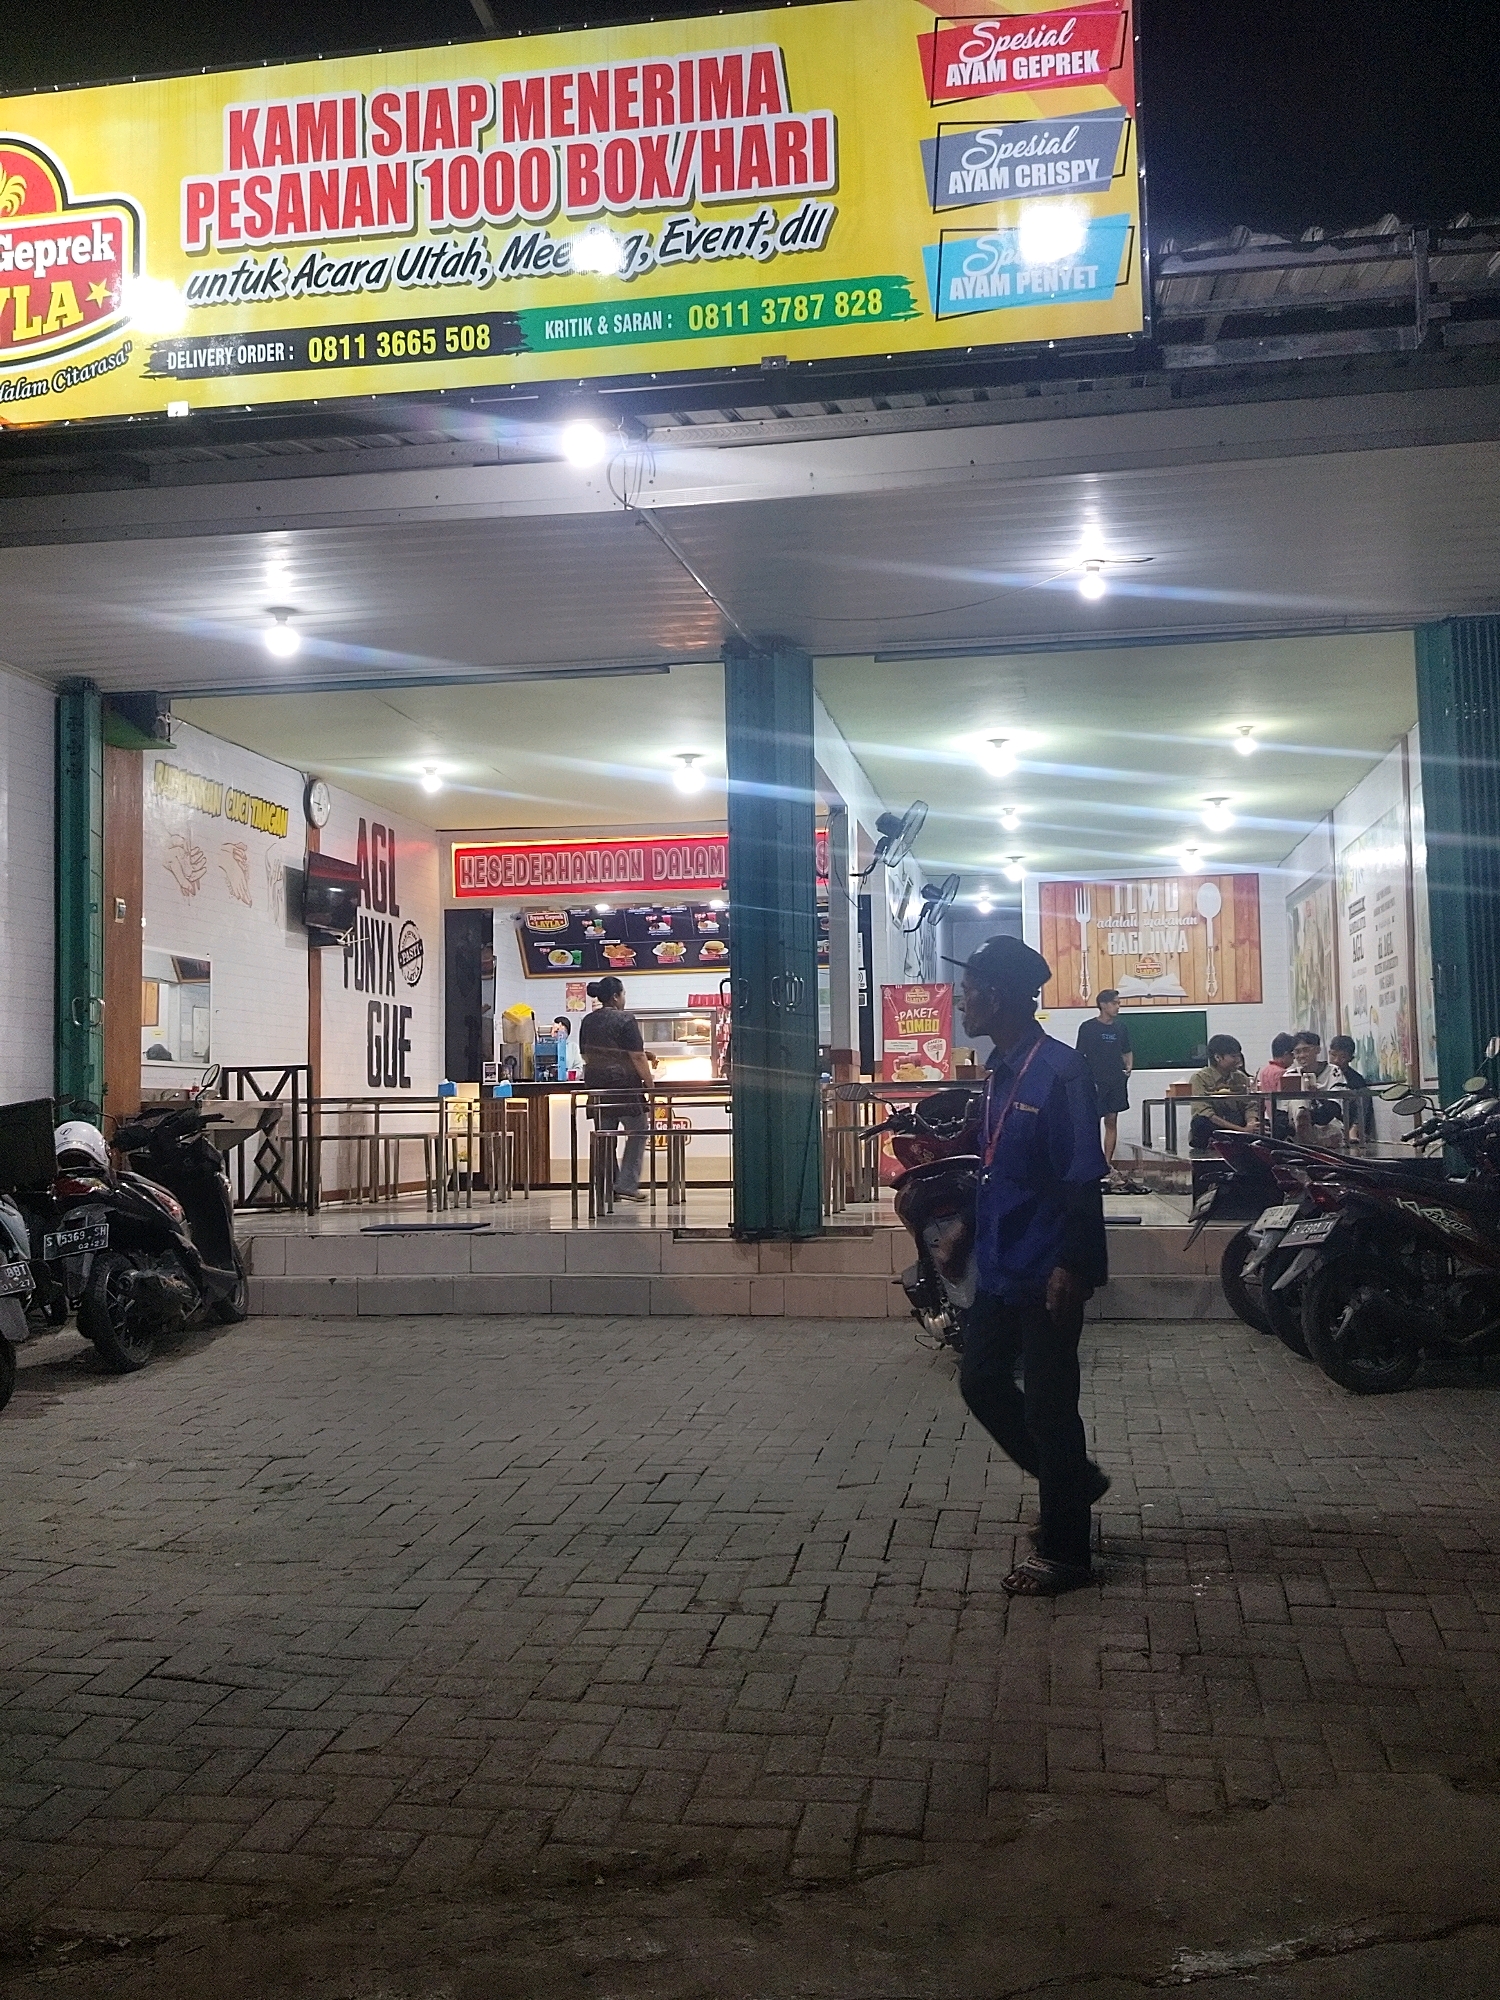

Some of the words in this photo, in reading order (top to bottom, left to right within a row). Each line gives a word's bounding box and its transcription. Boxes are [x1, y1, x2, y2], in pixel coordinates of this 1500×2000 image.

[959, 17, 1077, 64] Spesial
[946, 60, 1006, 87] AYAM
[1013, 50, 1100, 80] GEPREK
[229, 97, 356, 170] KAMI
[372, 85, 487, 156] SIAP
[502, 51, 781, 143] MENERIMA
[962, 125, 1080, 171] Spesial
[187, 162, 407, 244] PESANAN
[421, 147, 550, 221] 1000
[567, 118, 828, 208] BOX/HARI
[949, 167, 1010, 194] AYAM
[1016, 158, 1099, 188] CRISPY
[187, 258, 282, 299] untuk
[291, 253, 388, 290] Acara
[399, 237, 487, 281] Ultah,
[659, 210, 769, 258] Event,
[779, 204, 828, 246] dll
[950, 273, 1010, 301] AYAM
[1016, 265, 1098, 296] PENYET
[545, 316, 593, 339] KRITIK
[598, 317, 608, 334] &
[613, 310, 663, 334] SARAN
[688, 301, 749, 331] 0811
[761, 294, 825, 324] 3787
[835, 288, 883, 318] 828
[167, 346, 235, 370] DELIVERY
[237, 343, 286, 366] ORDER
[308, 334, 366, 363] 0811
[376, 329, 437, 358] 3665
[446, 324, 491, 352] 508
[250, 796, 289, 839] TANGAN
[357, 817, 399, 917] AGL
[460, 849, 644, 888] KESEDERHANAAN
[652, 845, 725, 881] DALAM
[1114, 883, 1179, 913] ILMU
[1097, 915, 1138, 928] adalah
[1144, 914, 1198, 928] makanan
[1108, 931, 1143, 956] BAGI
[1147, 930, 1189, 954] JIWA
[898, 1019, 940, 1034] COMBO
[900, 1008, 934, 1021] PAKET
[367, 1000, 412, 1088] GUE
[46, 1236, 53, 1247] S
